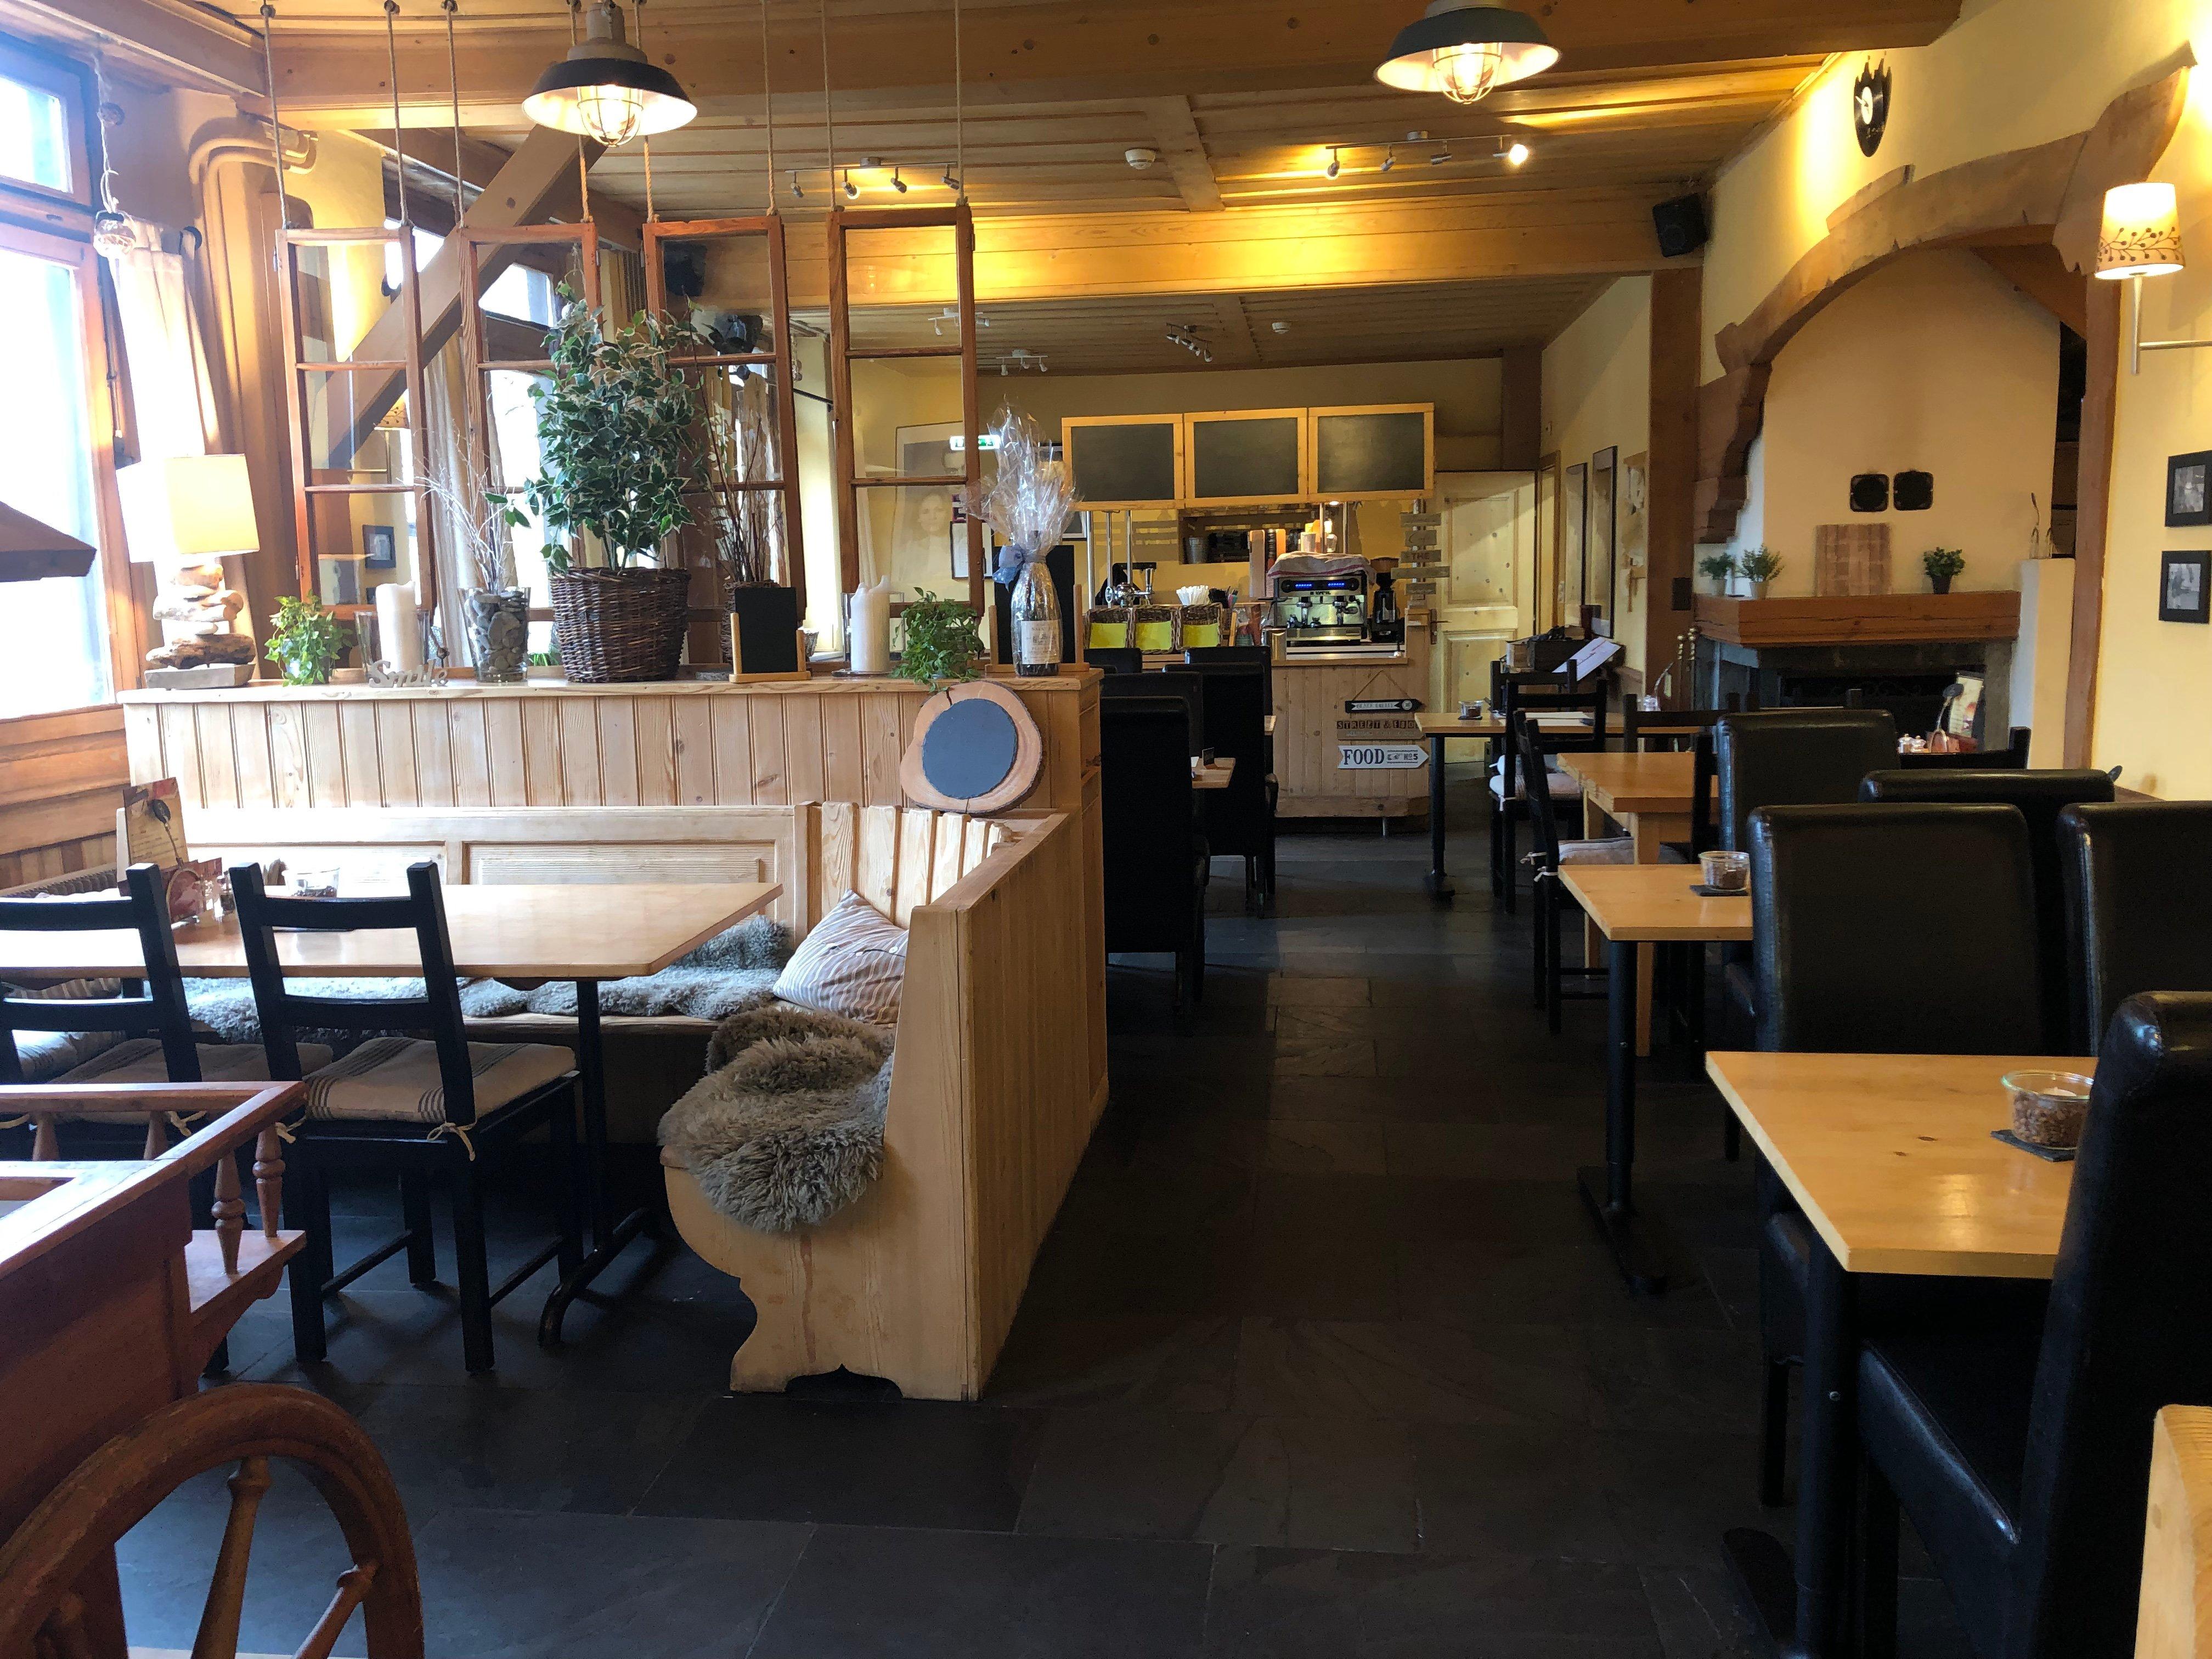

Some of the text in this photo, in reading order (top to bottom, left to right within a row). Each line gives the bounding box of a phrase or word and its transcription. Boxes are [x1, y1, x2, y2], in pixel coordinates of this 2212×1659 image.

[369, 659, 448, 688] Smile
[1337, 720, 1380, 729] STREET
[1393, 720, 1418, 729] FOO
[1343, 748, 1385, 765] FOOD
